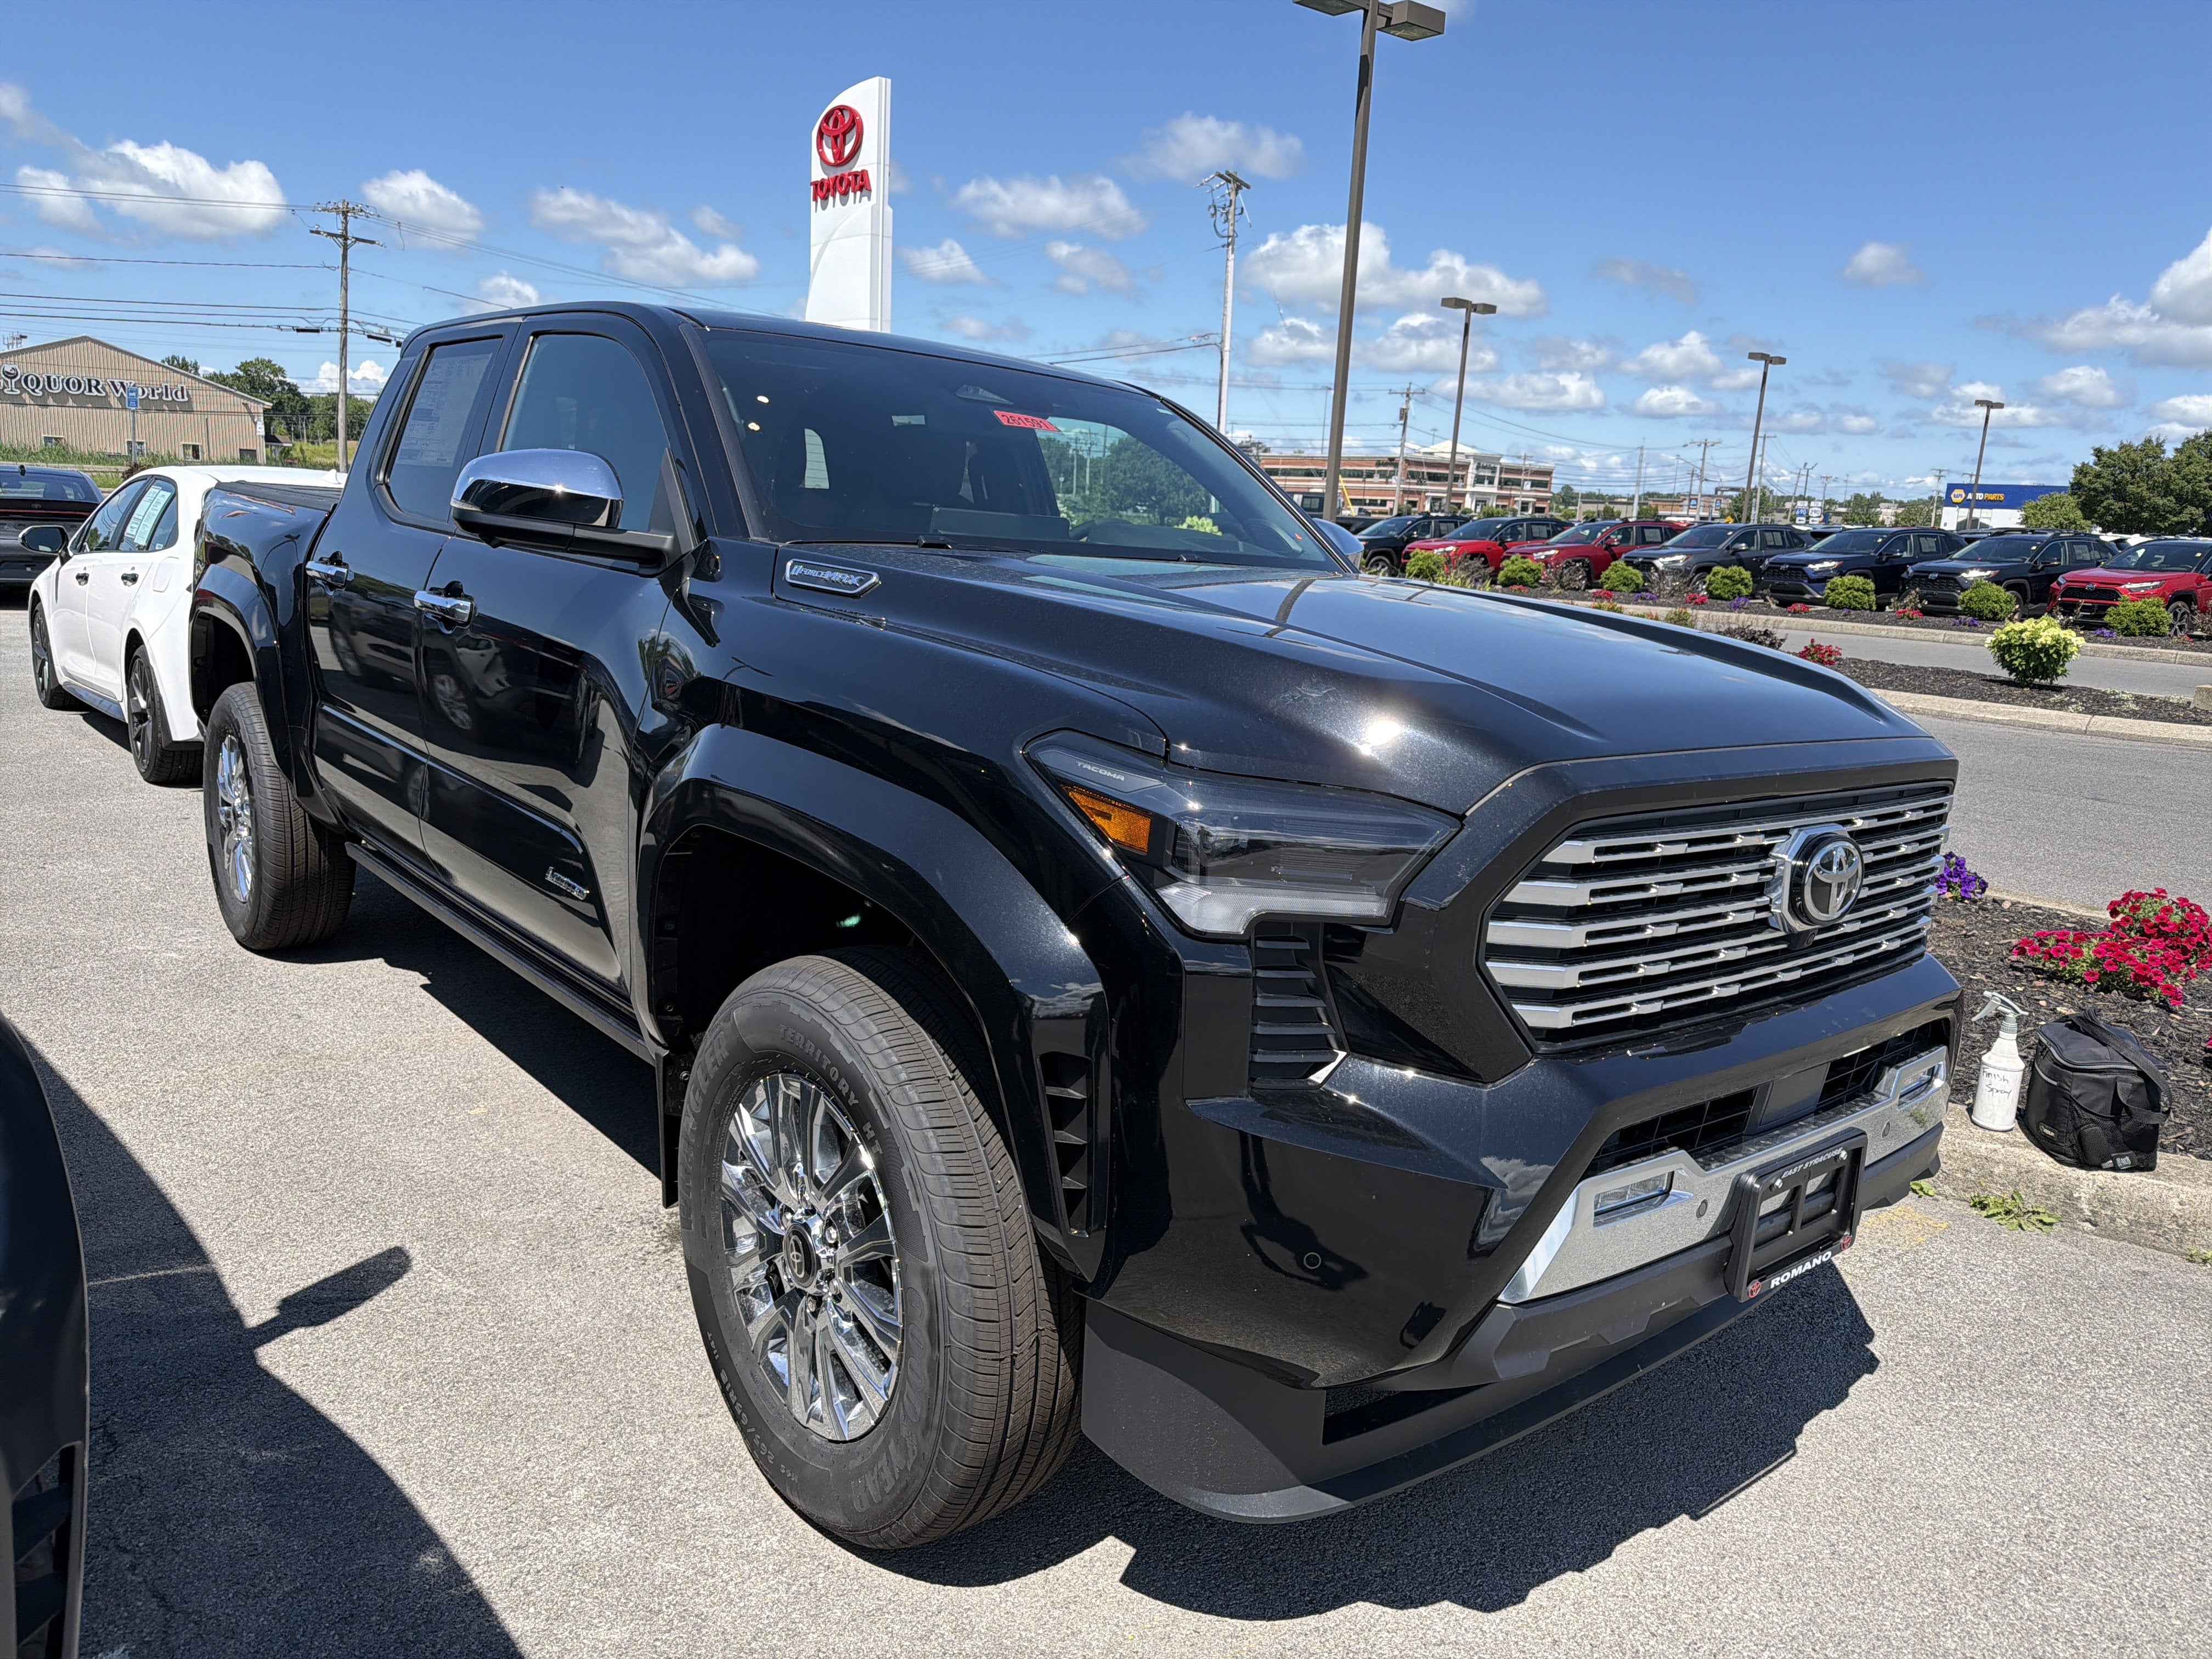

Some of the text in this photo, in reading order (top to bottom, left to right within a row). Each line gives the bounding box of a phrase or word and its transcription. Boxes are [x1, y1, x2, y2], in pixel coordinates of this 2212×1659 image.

[810, 170, 872, 201] TOYOTA
[1001, 415, 1049, 430] 261591
[1075, 760, 1125, 782] TACOMA
[779, 1024, 884, 1154] TERRITORY HT
[1985, 1084, 2012, 1100] Spray
[1781, 1147, 1844, 1179] EAST SYRACUSE
[1770, 1251, 1832, 1289] ROMANO
